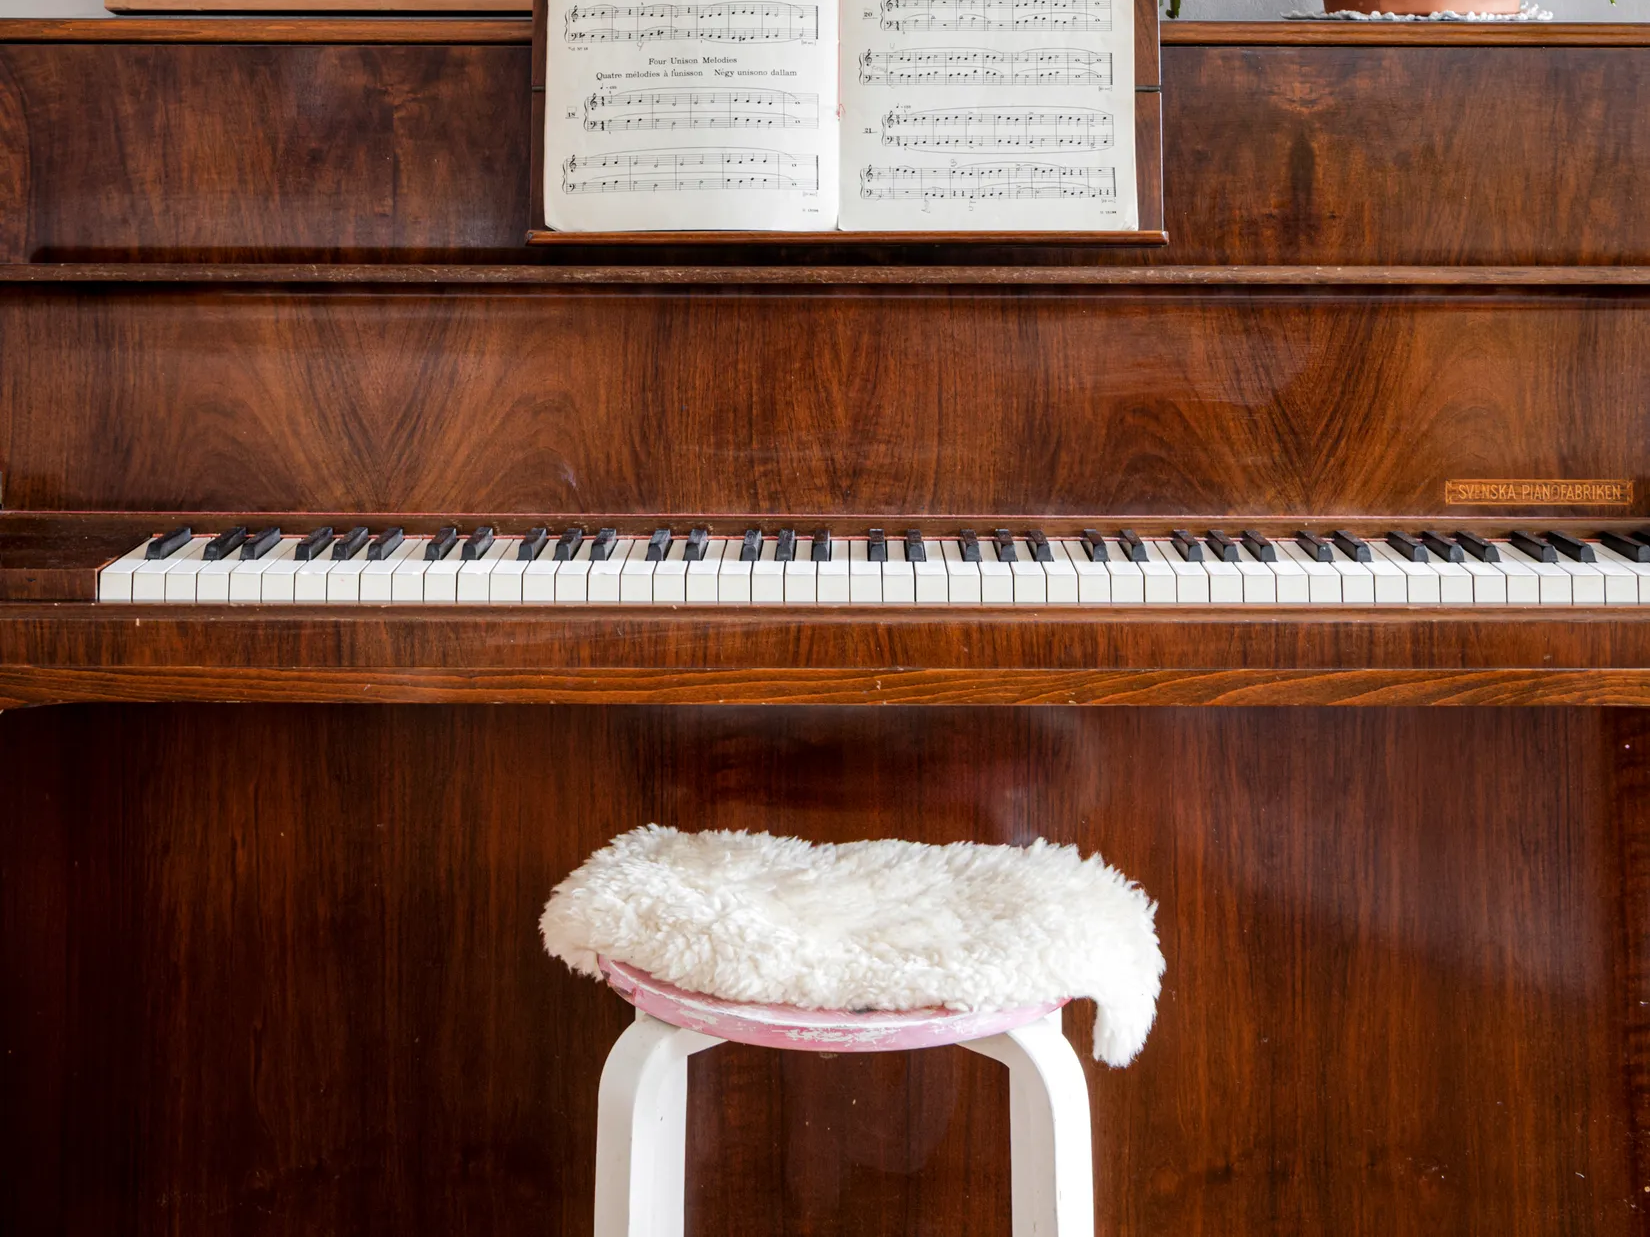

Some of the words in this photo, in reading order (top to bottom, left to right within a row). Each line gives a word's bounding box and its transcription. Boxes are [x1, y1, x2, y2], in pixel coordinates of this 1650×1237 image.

[670, 57, 698, 65] Unison
[702, 56, 738, 64] Melodies
[596, 72, 622, 81] Quatre
[625, 70, 660, 79] mélodies
[714, 68, 734, 78] Négy
[737, 69, 768, 77] unisono
[770, 68, 797, 76] dallam
[1458, 484, 1516, 500] SVENSKA
[1522, 484, 1621, 500] PIANOFABRIKEN
